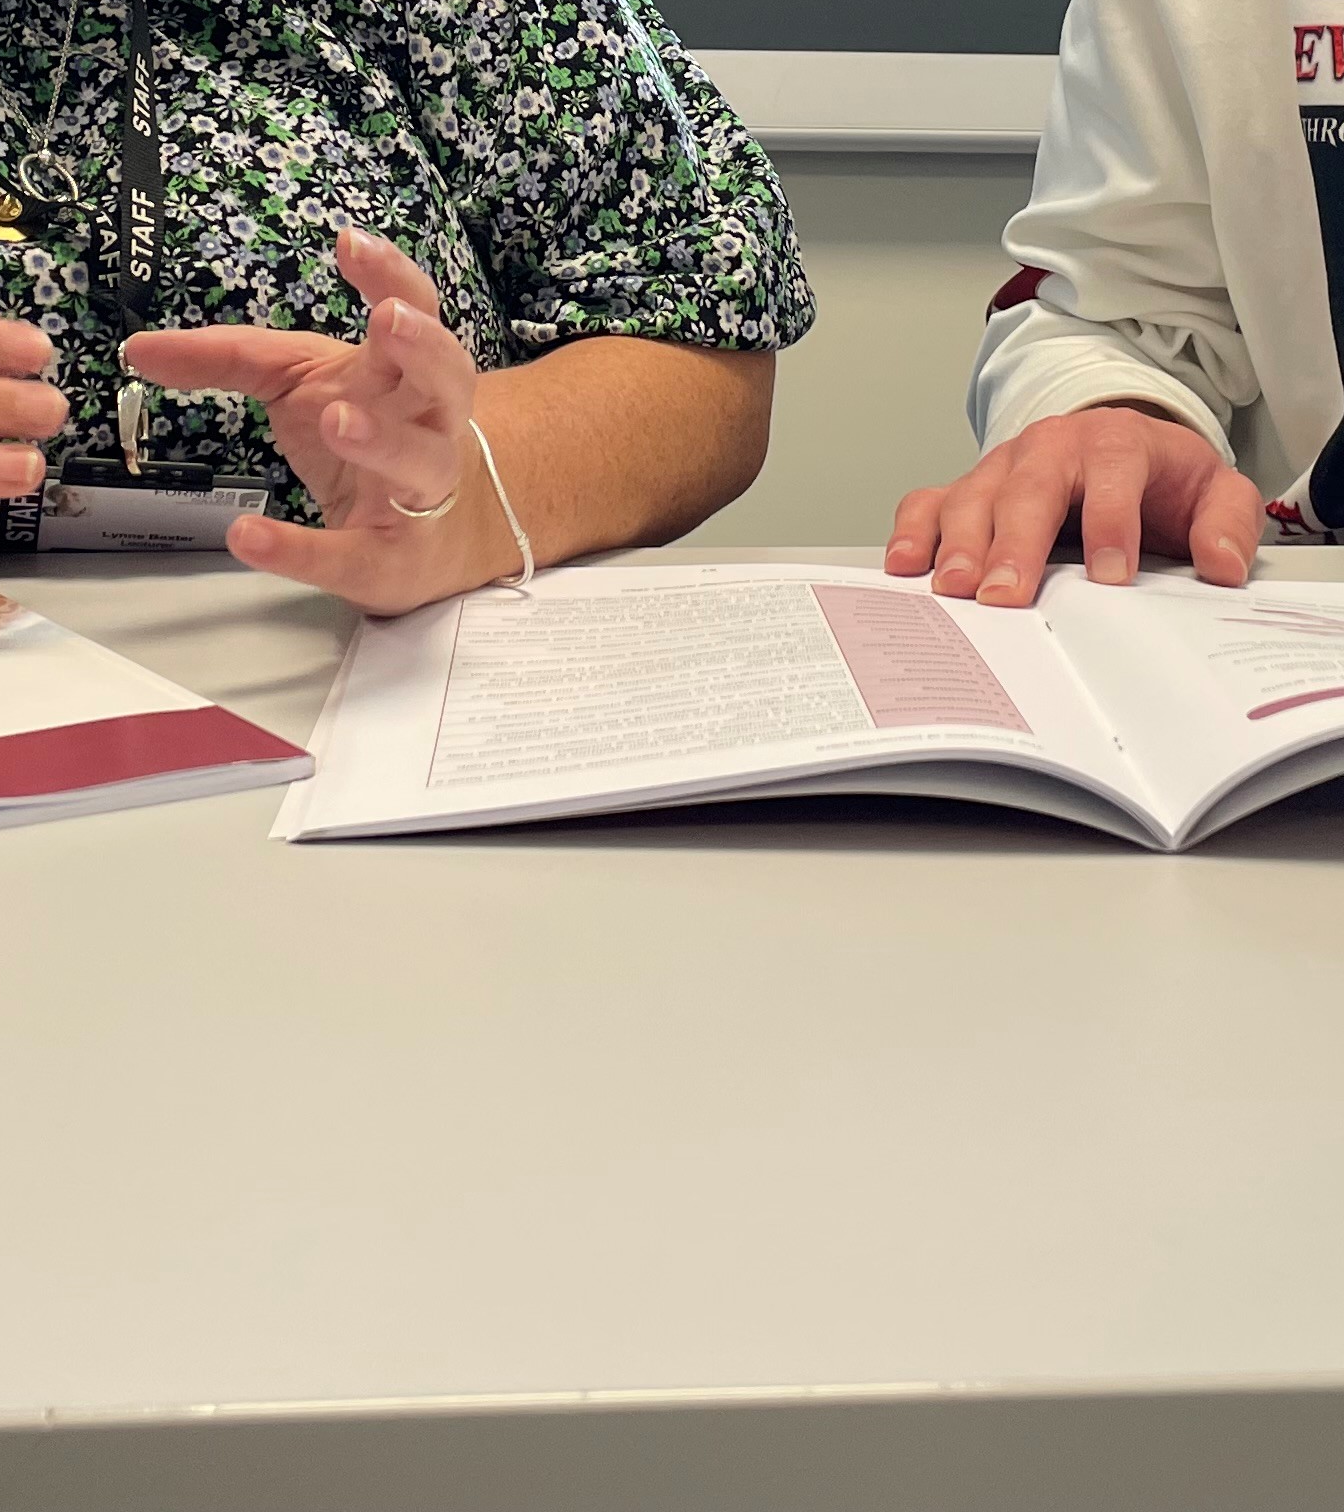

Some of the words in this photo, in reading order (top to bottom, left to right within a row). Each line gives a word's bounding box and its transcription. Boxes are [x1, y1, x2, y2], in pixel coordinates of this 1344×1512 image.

[133, 53, 153, 137] STAFF
[96, 210, 121, 289] TAFF
[131, 188, 156, 283] STAFF
